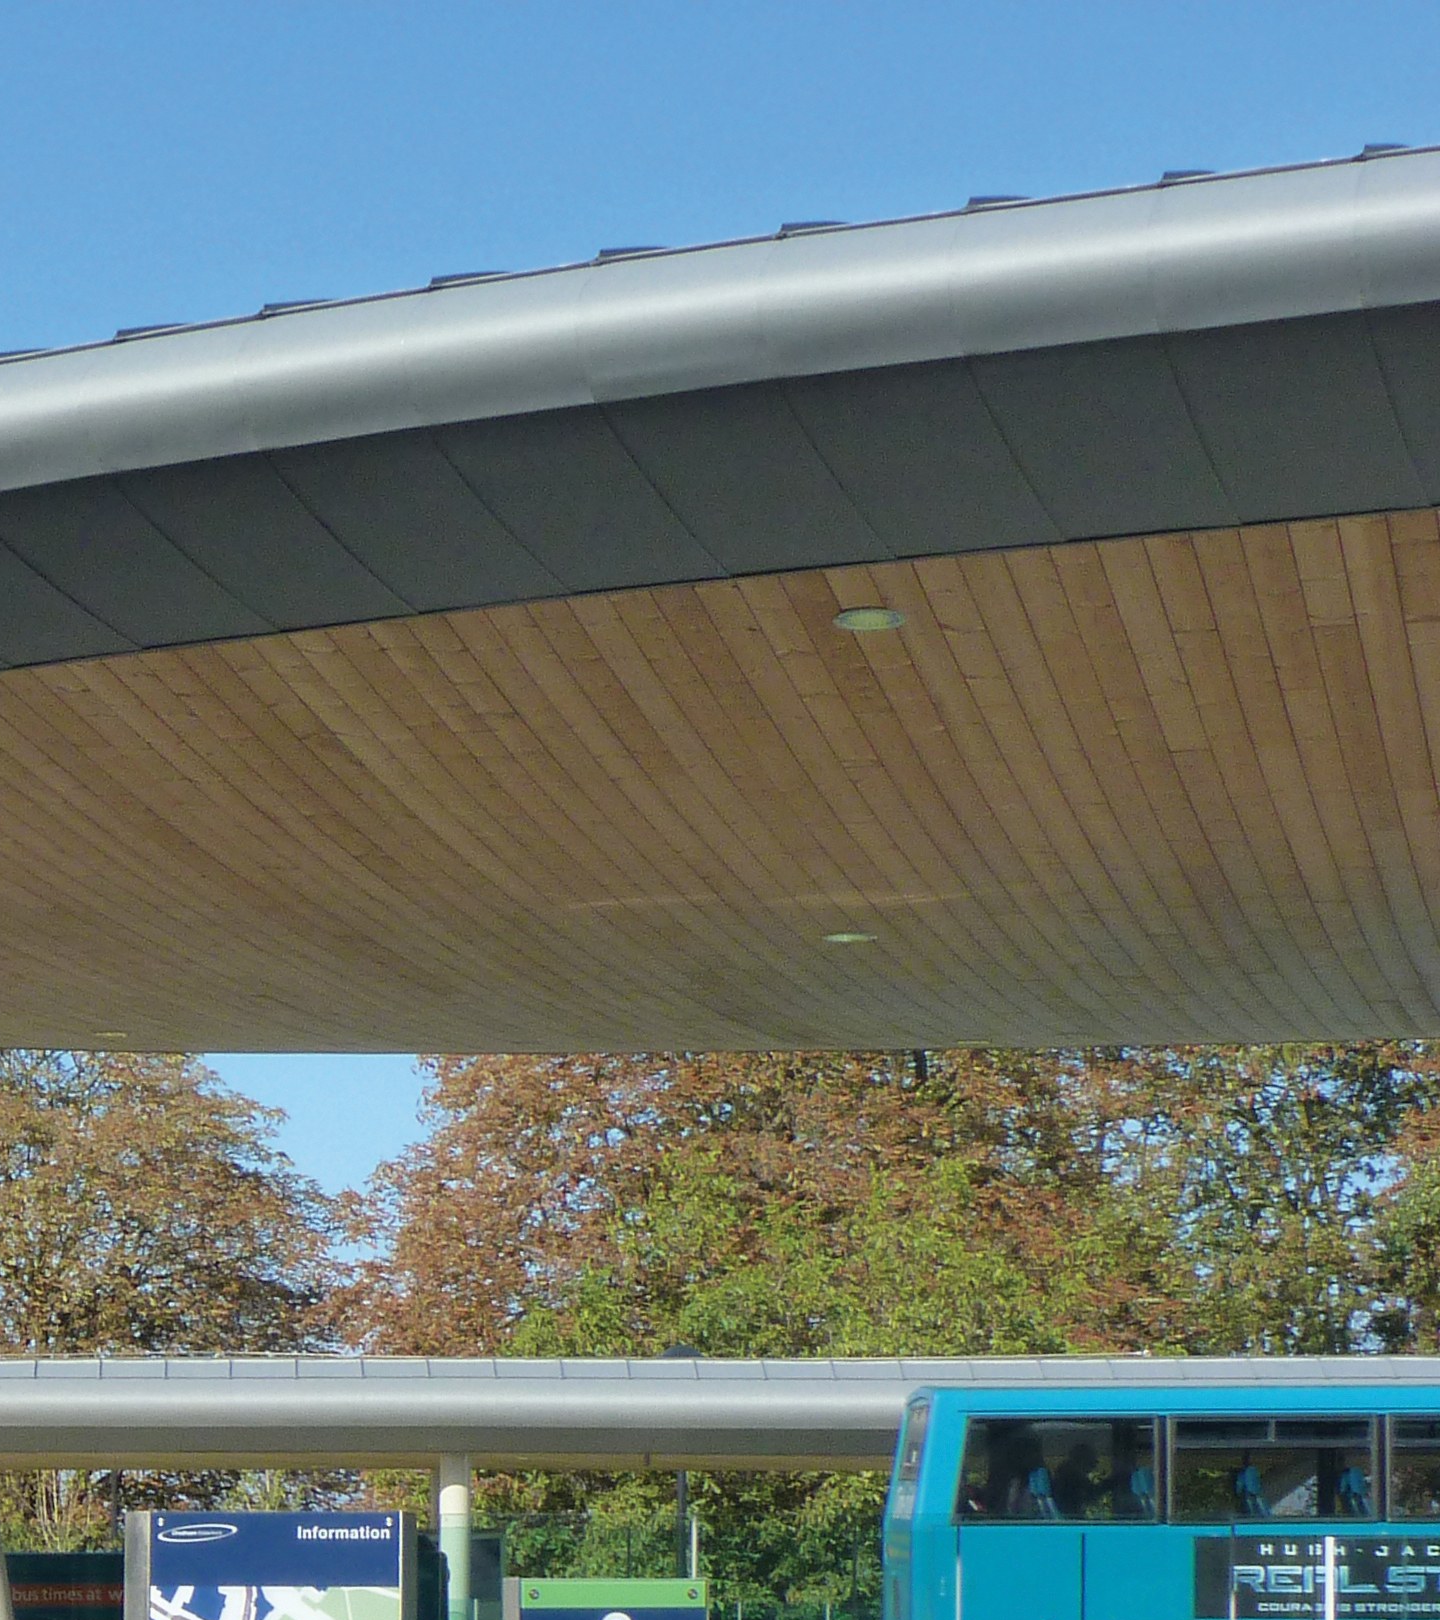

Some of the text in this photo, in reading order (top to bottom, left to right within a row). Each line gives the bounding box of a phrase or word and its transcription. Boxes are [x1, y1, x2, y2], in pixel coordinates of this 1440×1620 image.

[297, 1525, 391, 1540] Information
[1373, 1545, 1440, 1557] JAC
[1232, 1565, 1381, 1594] REAL
[12, 1586, 39, 1601] bus
[42, 1585, 83, 1601] times
[87, 1587, 102, 1601] at
